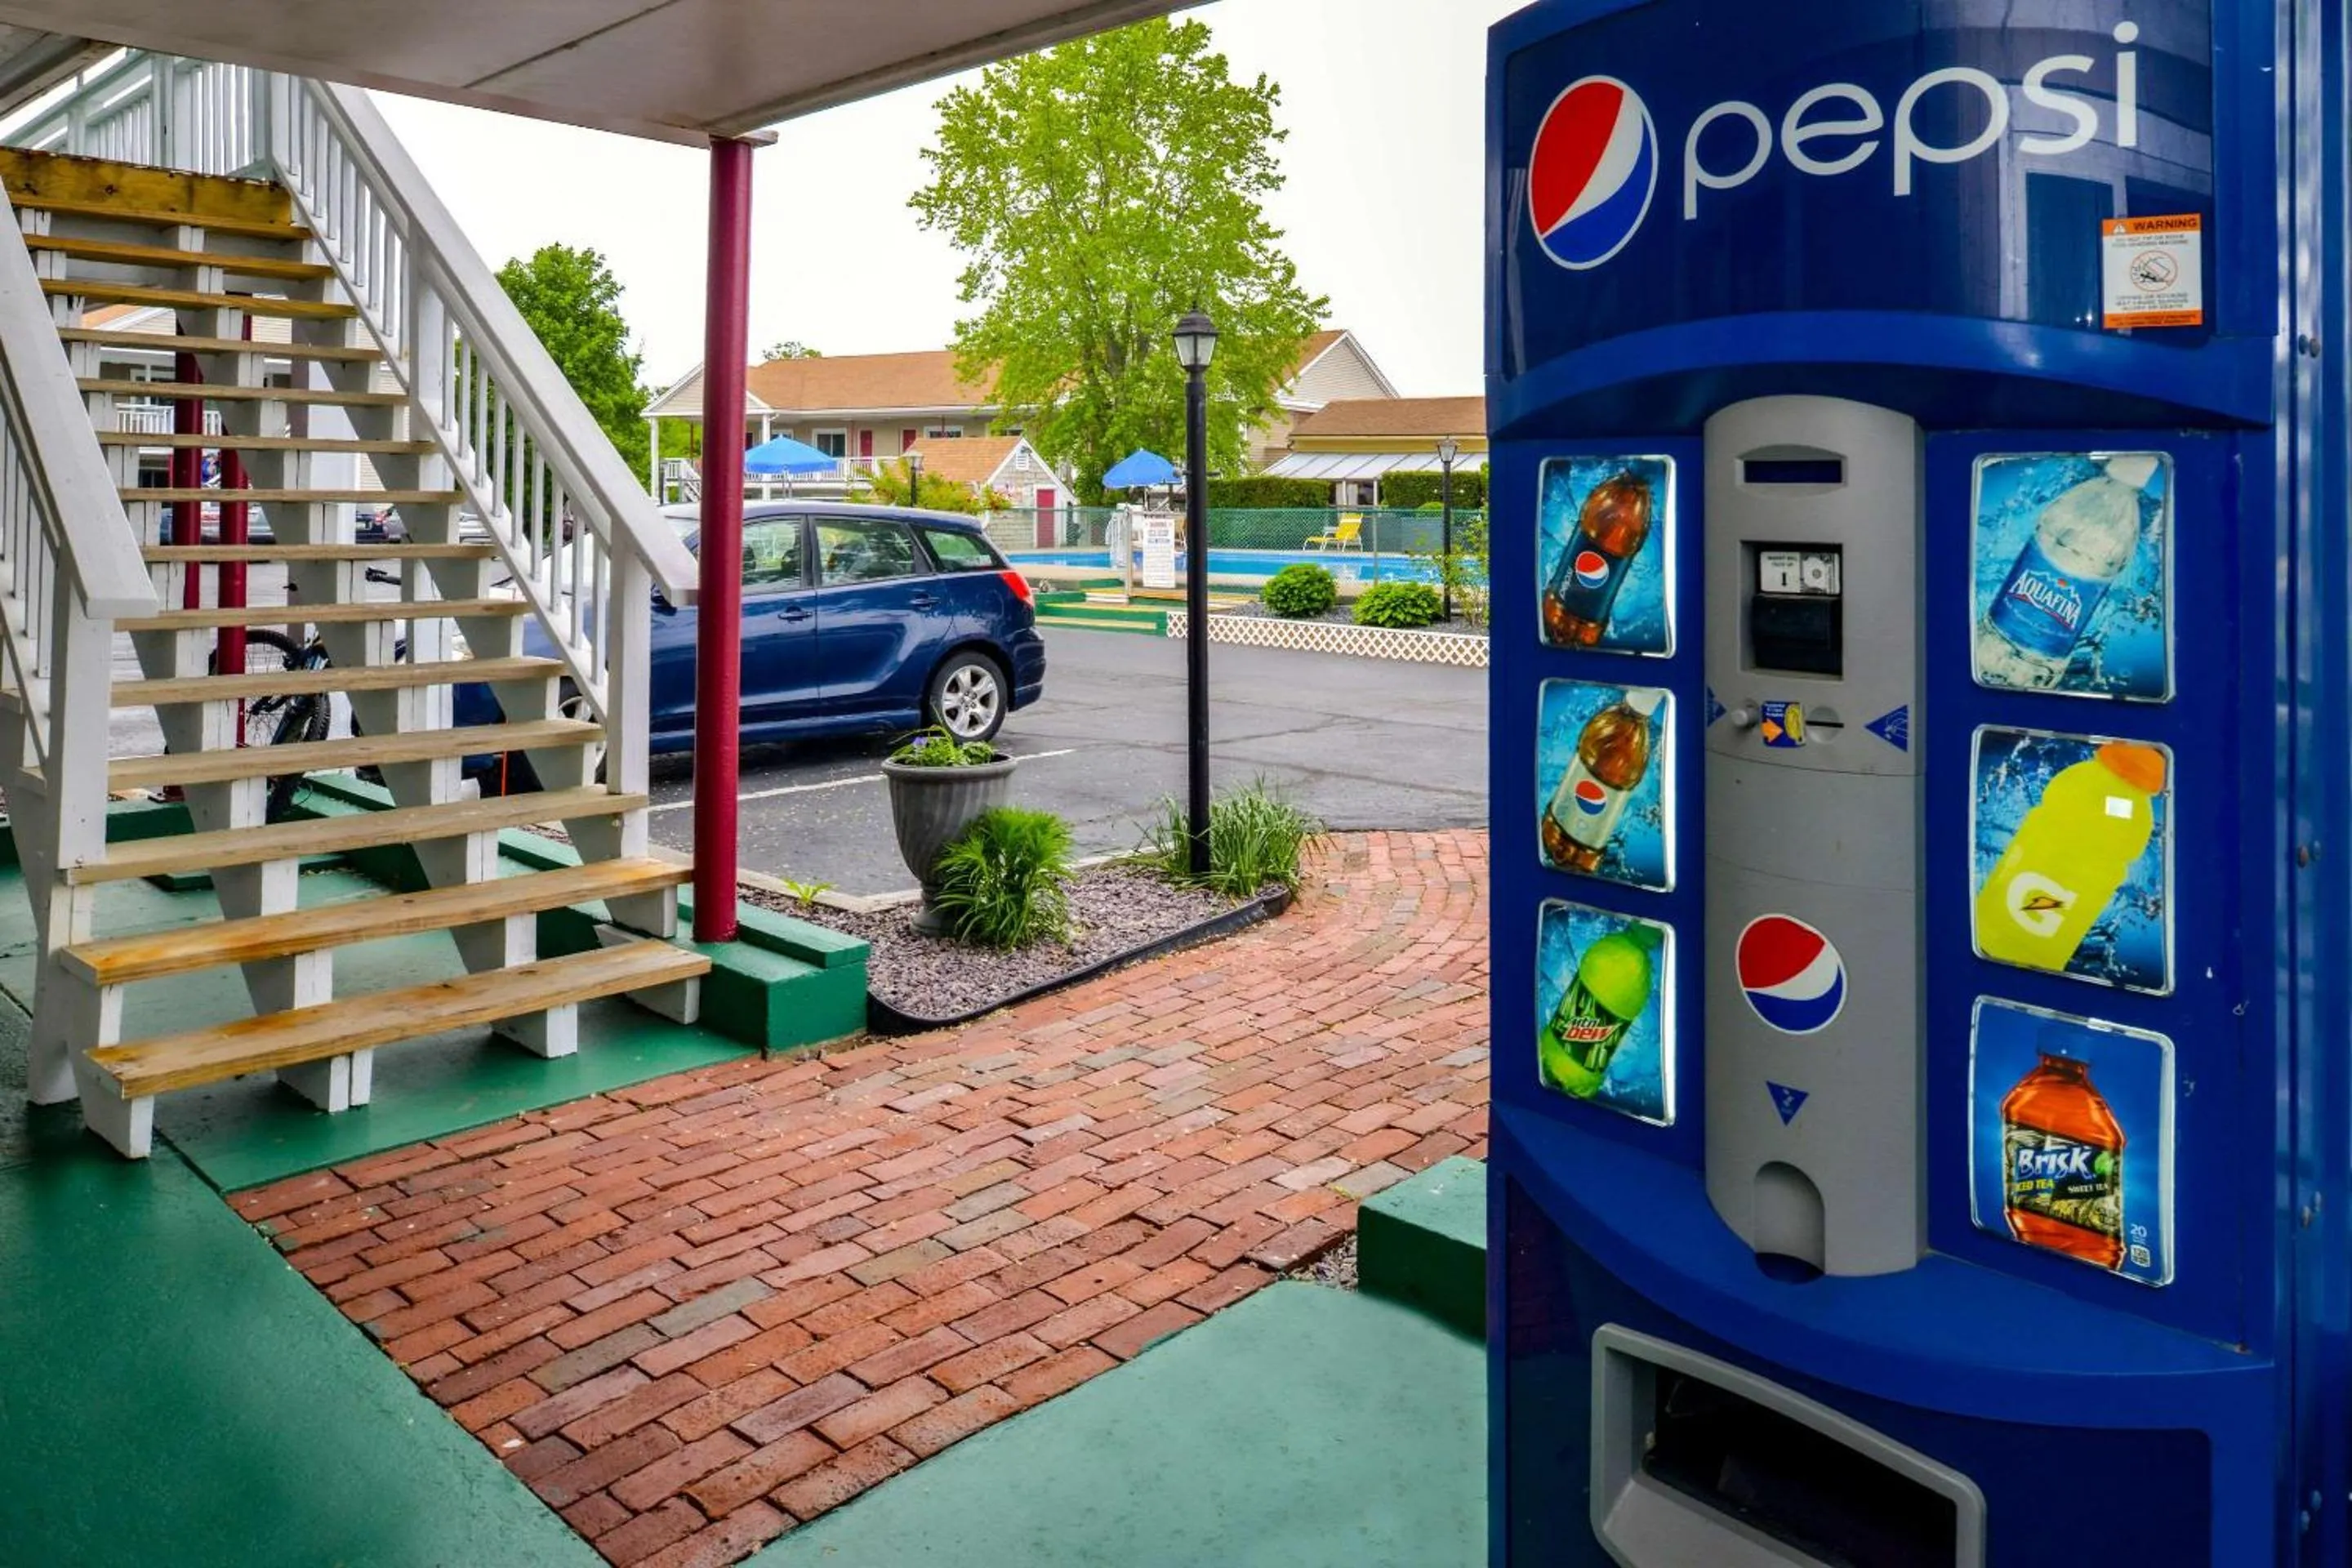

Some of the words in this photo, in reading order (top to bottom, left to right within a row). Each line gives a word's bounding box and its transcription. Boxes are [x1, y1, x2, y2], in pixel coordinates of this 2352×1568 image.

[1684, 21, 2139, 220] pepsi
[2133, 218, 2198, 231] WARNING
[2008, 568, 2082, 630] AQUAFINA
[2036, 1178, 2056, 1190] TEA
